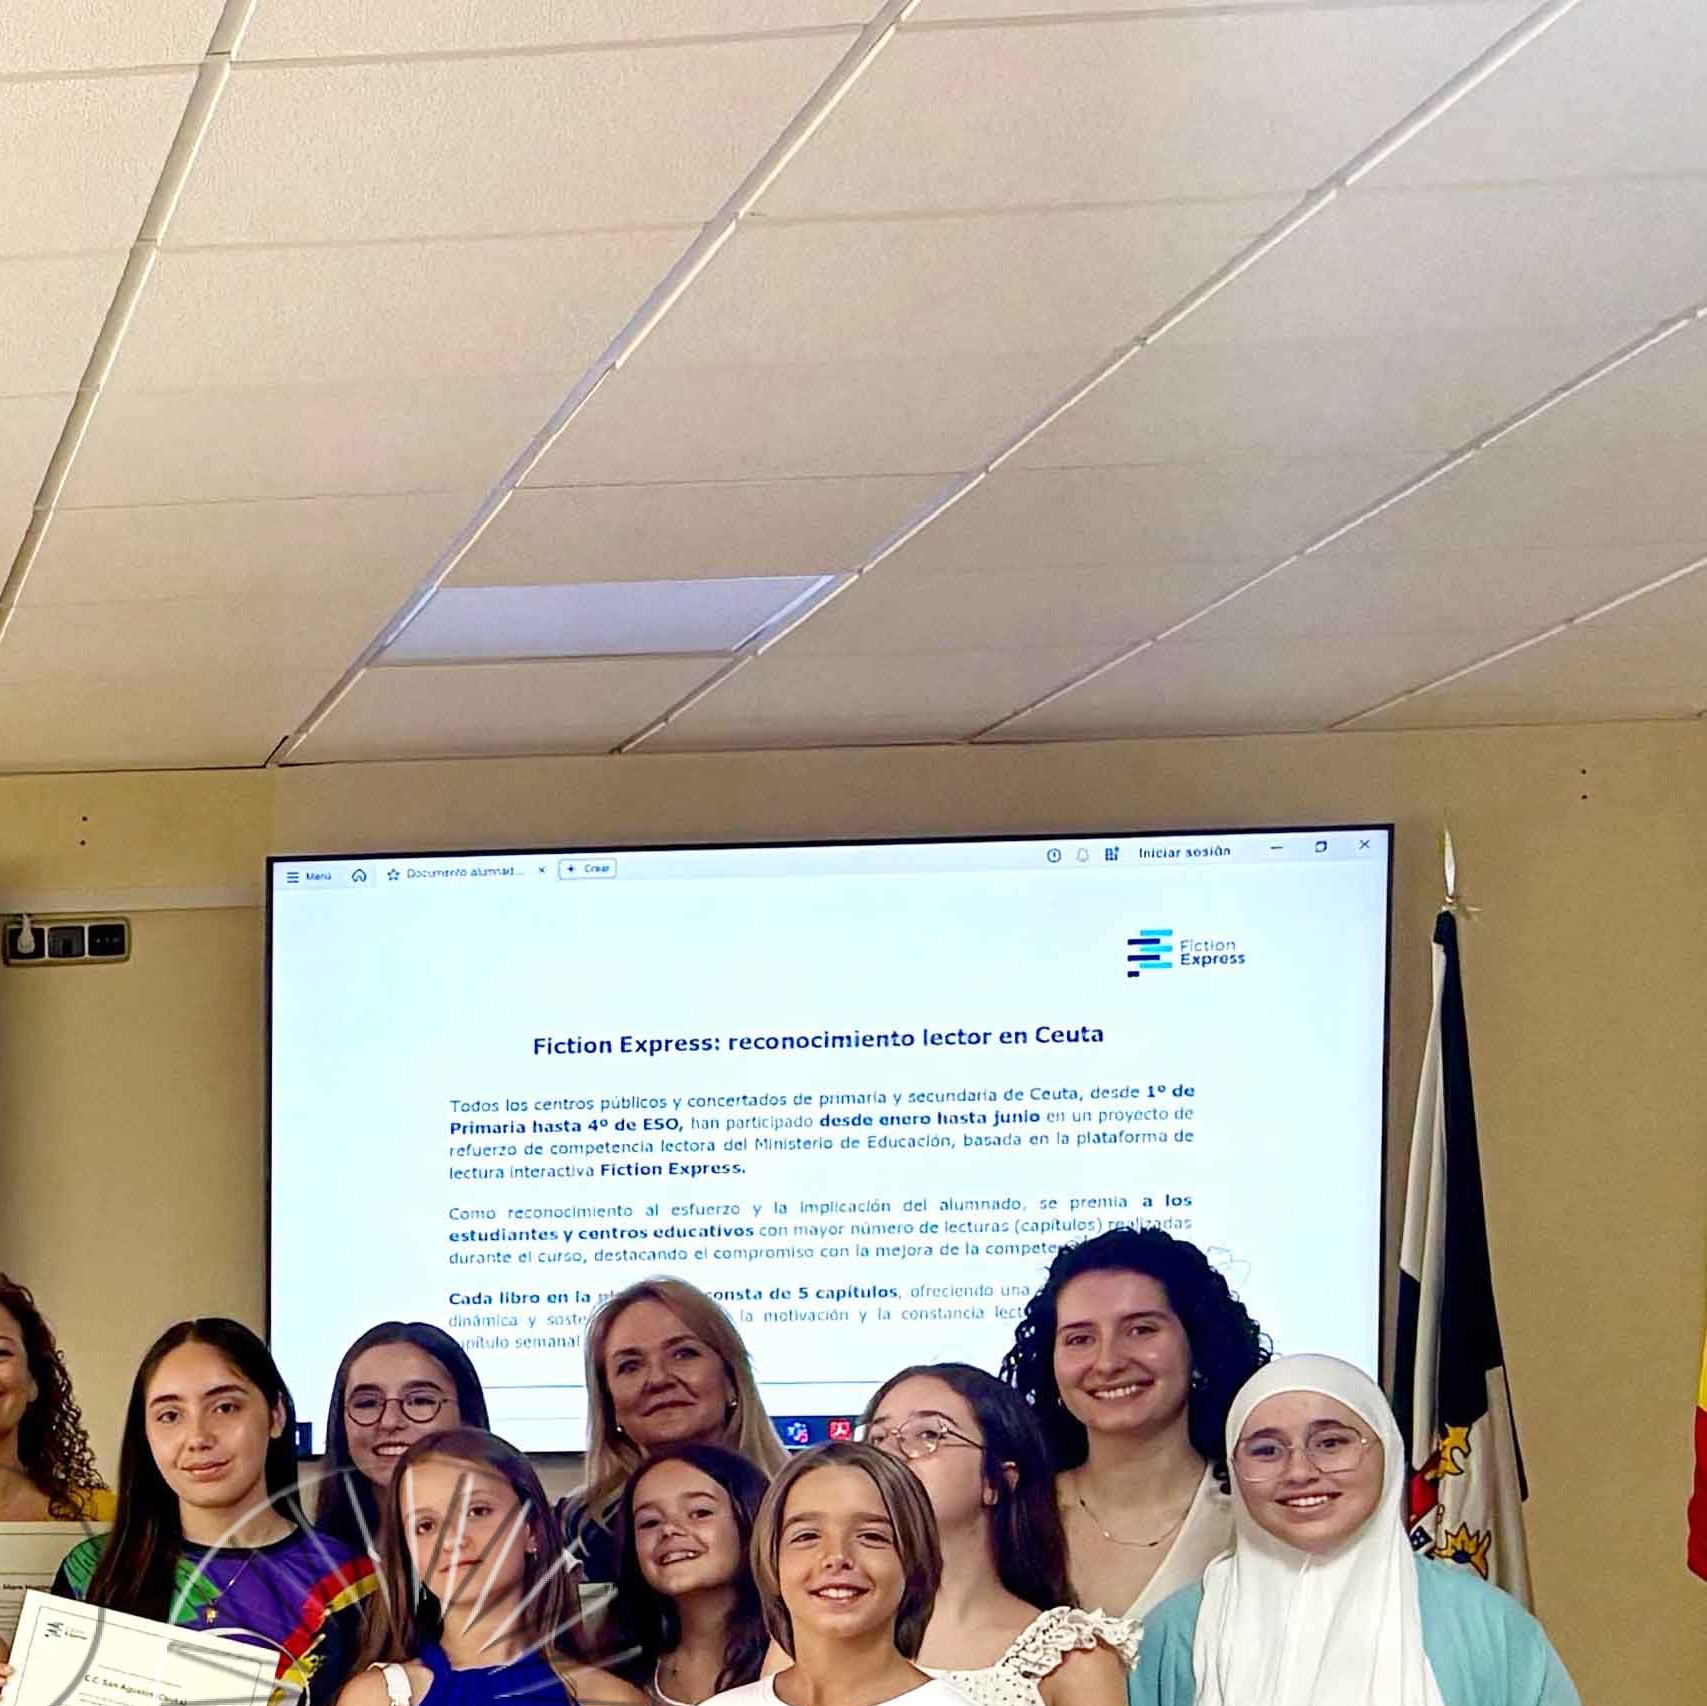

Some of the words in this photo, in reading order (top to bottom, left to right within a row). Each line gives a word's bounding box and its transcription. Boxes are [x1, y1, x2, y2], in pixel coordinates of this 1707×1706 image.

[1139, 847, 1181, 859] Iniciar
[407, 867, 467, 879] Documento
[1180, 939, 1236, 952] Fiction
[1180, 953, 1246, 968] Express
[533, 1035, 612, 1055] Fiction
[620, 1033, 721, 1058] Express:
[729, 1032, 915, 1051] reconocimiento
[923, 1027, 991, 1047] lector
[999, 1031, 1027, 1045] en
[1037, 1025, 1105, 1045] Ceuta
[450, 1097, 498, 1113] Todos
[505, 1096, 528, 1112] los
[534, 1096, 594, 1111] centros
[600, 1094, 667, 1113] públicos
[672, 1097, 681, 1112] y
[687, 1091, 786, 1108] concertados
[793, 1090, 812, 1106] de
[819, 1090, 886, 1109] primaria
[892, 1092, 901, 1107] y
[908, 1087, 997, 1103] secundaria
[1003, 1086, 1024, 1101] de
[1090, 1084, 1139, 1099] desde
[1171, 1082, 1195, 1098] de
[451, 1119, 526, 1135] Primaria
[532, 1117, 582, 1133] hasta
[614, 1116, 636, 1132] de
[691, 1115, 719, 1130] han
[726, 1113, 813, 1133] participado
[819, 1112, 873, 1128] desde
[878, 1115, 931, 1127] enero
[937, 1110, 987, 1126] hasta
[994, 1110, 1040, 1128] junio
[1046, 1112, 1065, 1123] en
[1072, 1112, 1091, 1123] un
[1098, 1108, 1168, 1126] proyecto
[1174, 1106, 1193, 1121] de
[449, 1141, 517, 1157] refuerzo
[523, 1140, 543, 1155] de
[549, 1139, 653, 1159] competencia
[660, 1137, 715, 1153] lectora
[723, 1137, 747, 1152] del
[755, 1135, 833, 1151] Ministerio
[839, 1134, 859, 1149] de
[963, 1132, 1021, 1147] basada
[1029, 1135, 1049, 1146] en
[1056, 1131, 1069, 1146] la
[1076, 1129, 1167, 1149] plataforma
[1173, 1128, 1194, 1143] de
[449, 1164, 504, 1179] lectura
[510, 1163, 594, 1178] interactiva
[600, 1161, 662, 1177] Fiction
[668, 1160, 746, 1180] Express.
[449, 1205, 496, 1220] Como
[507, 1204, 633, 1219] reconocimiento
[645, 1202, 659, 1217] al
[671, 1201, 739, 1216] esfuerzo
[752, 1204, 761, 1219] y
[773, 1200, 787, 1215] la
[799, 1198, 890, 1218] implicación
[903, 1197, 927, 1212] del
[1039, 1199, 1057, 1210] se
[1069, 1195, 1127, 1213] premia
[1142, 1197, 1153, 1208] a
[1165, 1193, 1193, 1208] los
[449, 1226, 558, 1242] estudiantes
[562, 1230, 573, 1244] y
[578, 1225, 647, 1240] centros
[653, 1223, 754, 1239] educativos
[759, 1226, 787, 1237] con
[794, 1225, 843, 1240] mayor
[851, 1220, 913, 1236] número
[919, 1220, 938, 1235] de
[944, 1218, 1008, 1234] lecturas
[1014, 1217, 1102, 1237] (capítulos)
